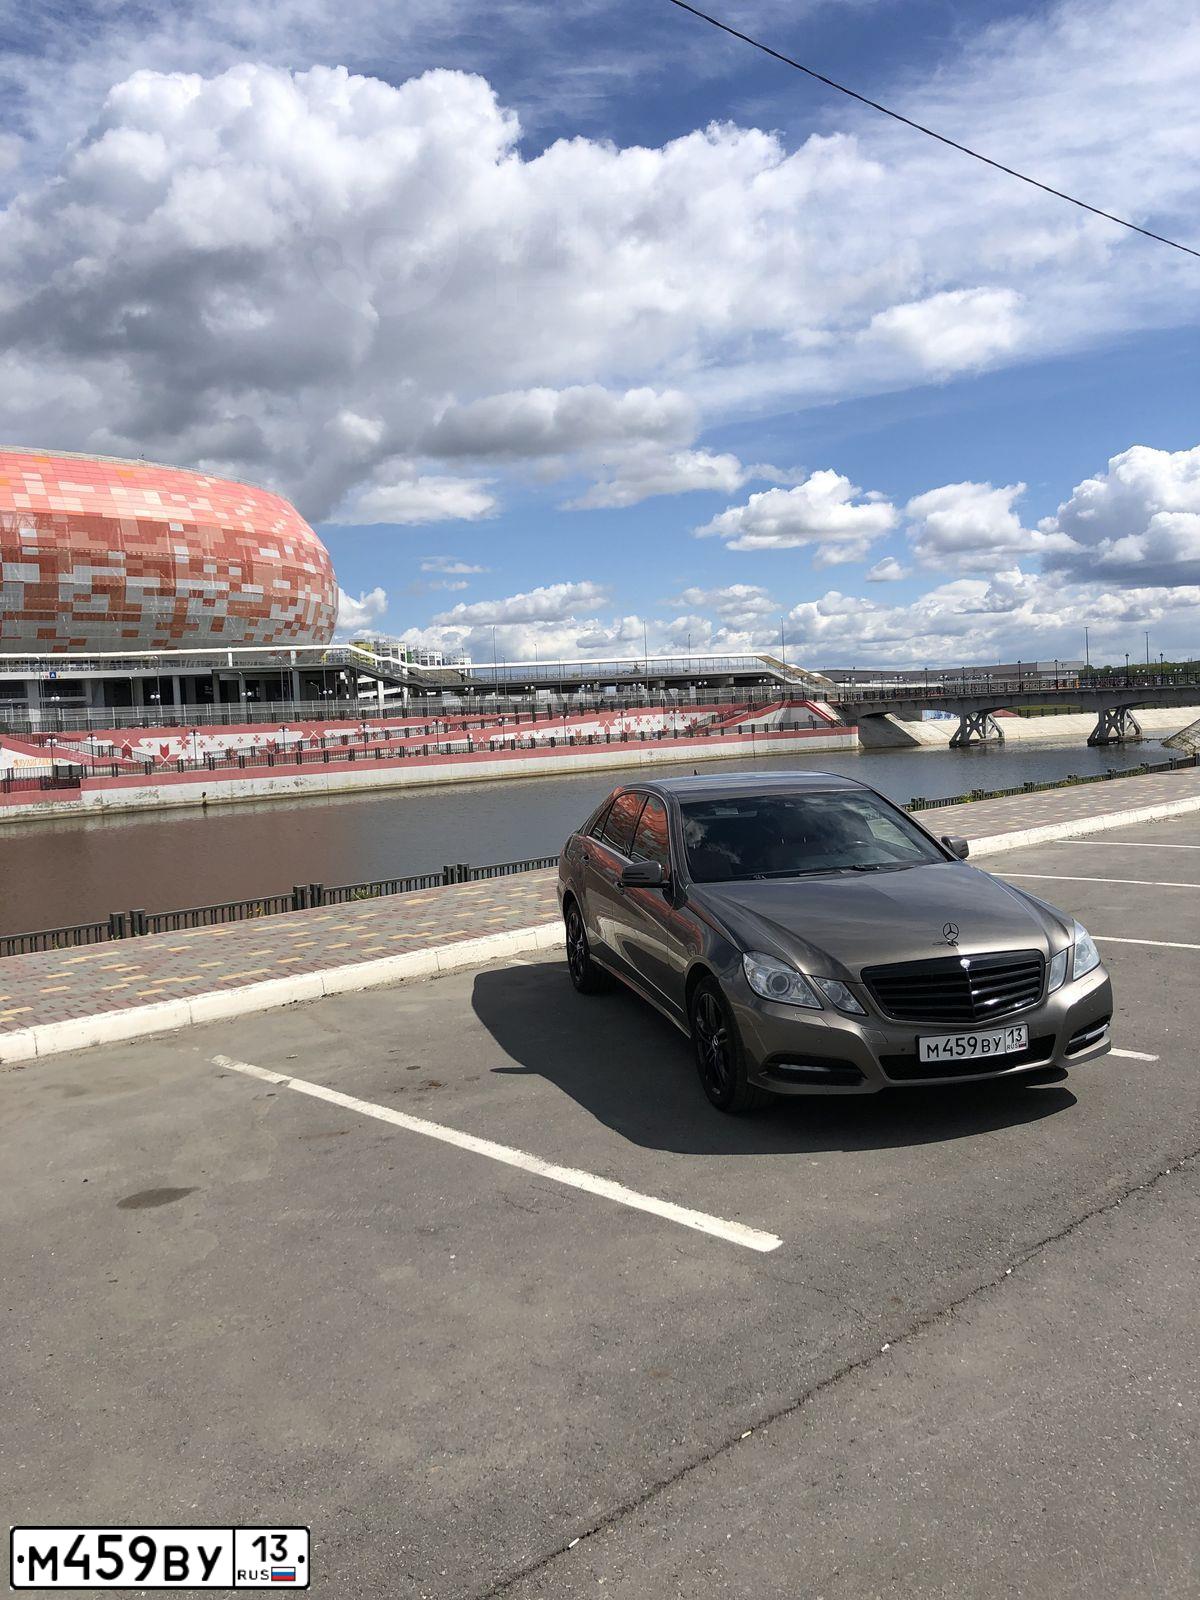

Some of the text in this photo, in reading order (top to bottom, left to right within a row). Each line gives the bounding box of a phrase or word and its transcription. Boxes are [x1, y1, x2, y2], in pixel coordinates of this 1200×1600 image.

[926, 1027, 1023, 1059] М459ВУ 13
[1006, 1042, 1019, 1050] RUS
